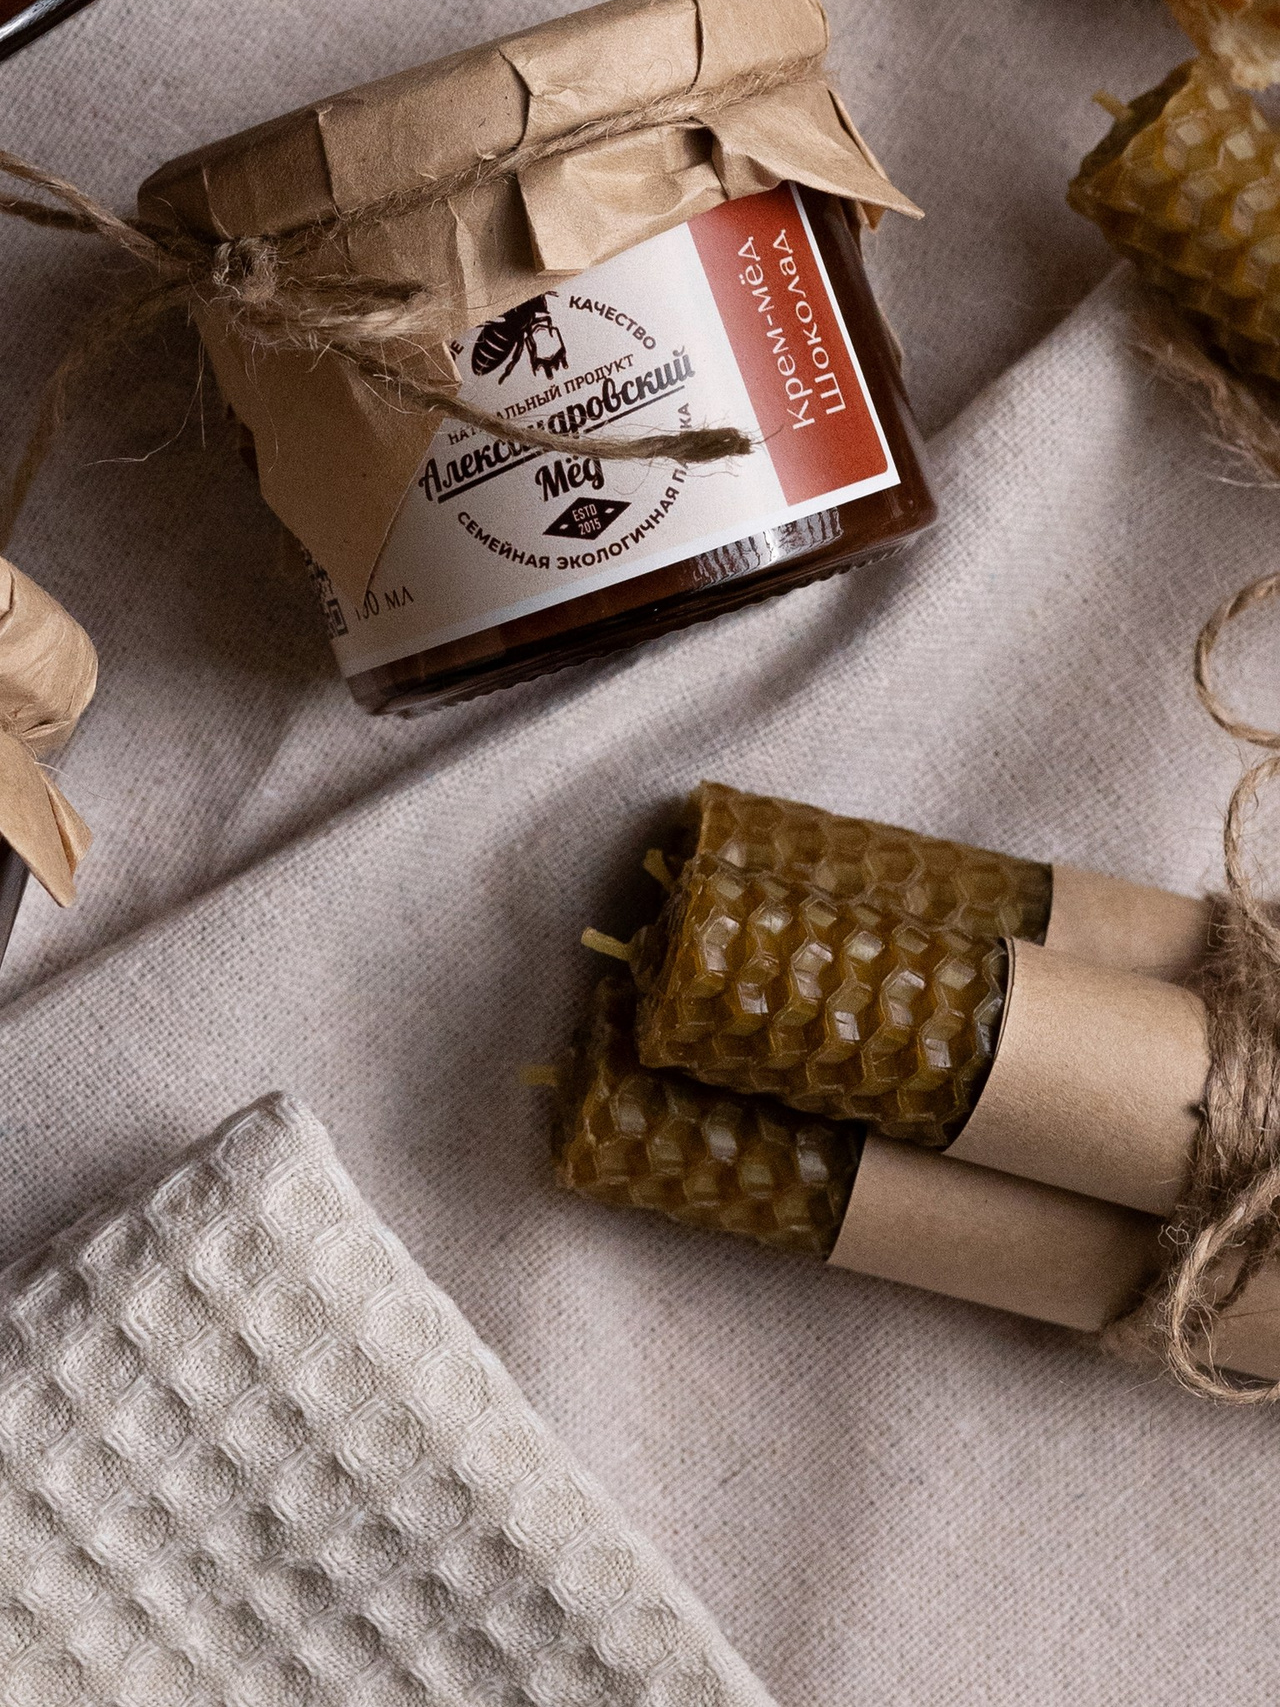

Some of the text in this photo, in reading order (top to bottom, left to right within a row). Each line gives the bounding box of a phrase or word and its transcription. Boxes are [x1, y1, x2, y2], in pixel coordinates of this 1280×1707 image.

[569, 295, 657, 351] КАЧЕСТВО
[737, 236, 816, 431] Крем-мёд
[772, 228, 847, 415] Шоколад
[564, 354, 634, 394] ПРОДУКТ
[534, 455, 605, 502] Мёд
[457, 511, 550, 570] СЕМЕЙНАЯ
[556, 485, 680, 570] ЭКОЛОГИЧНАЯ
[572, 503, 598, 522] ESTD
[578, 517, 602, 536] 2015
